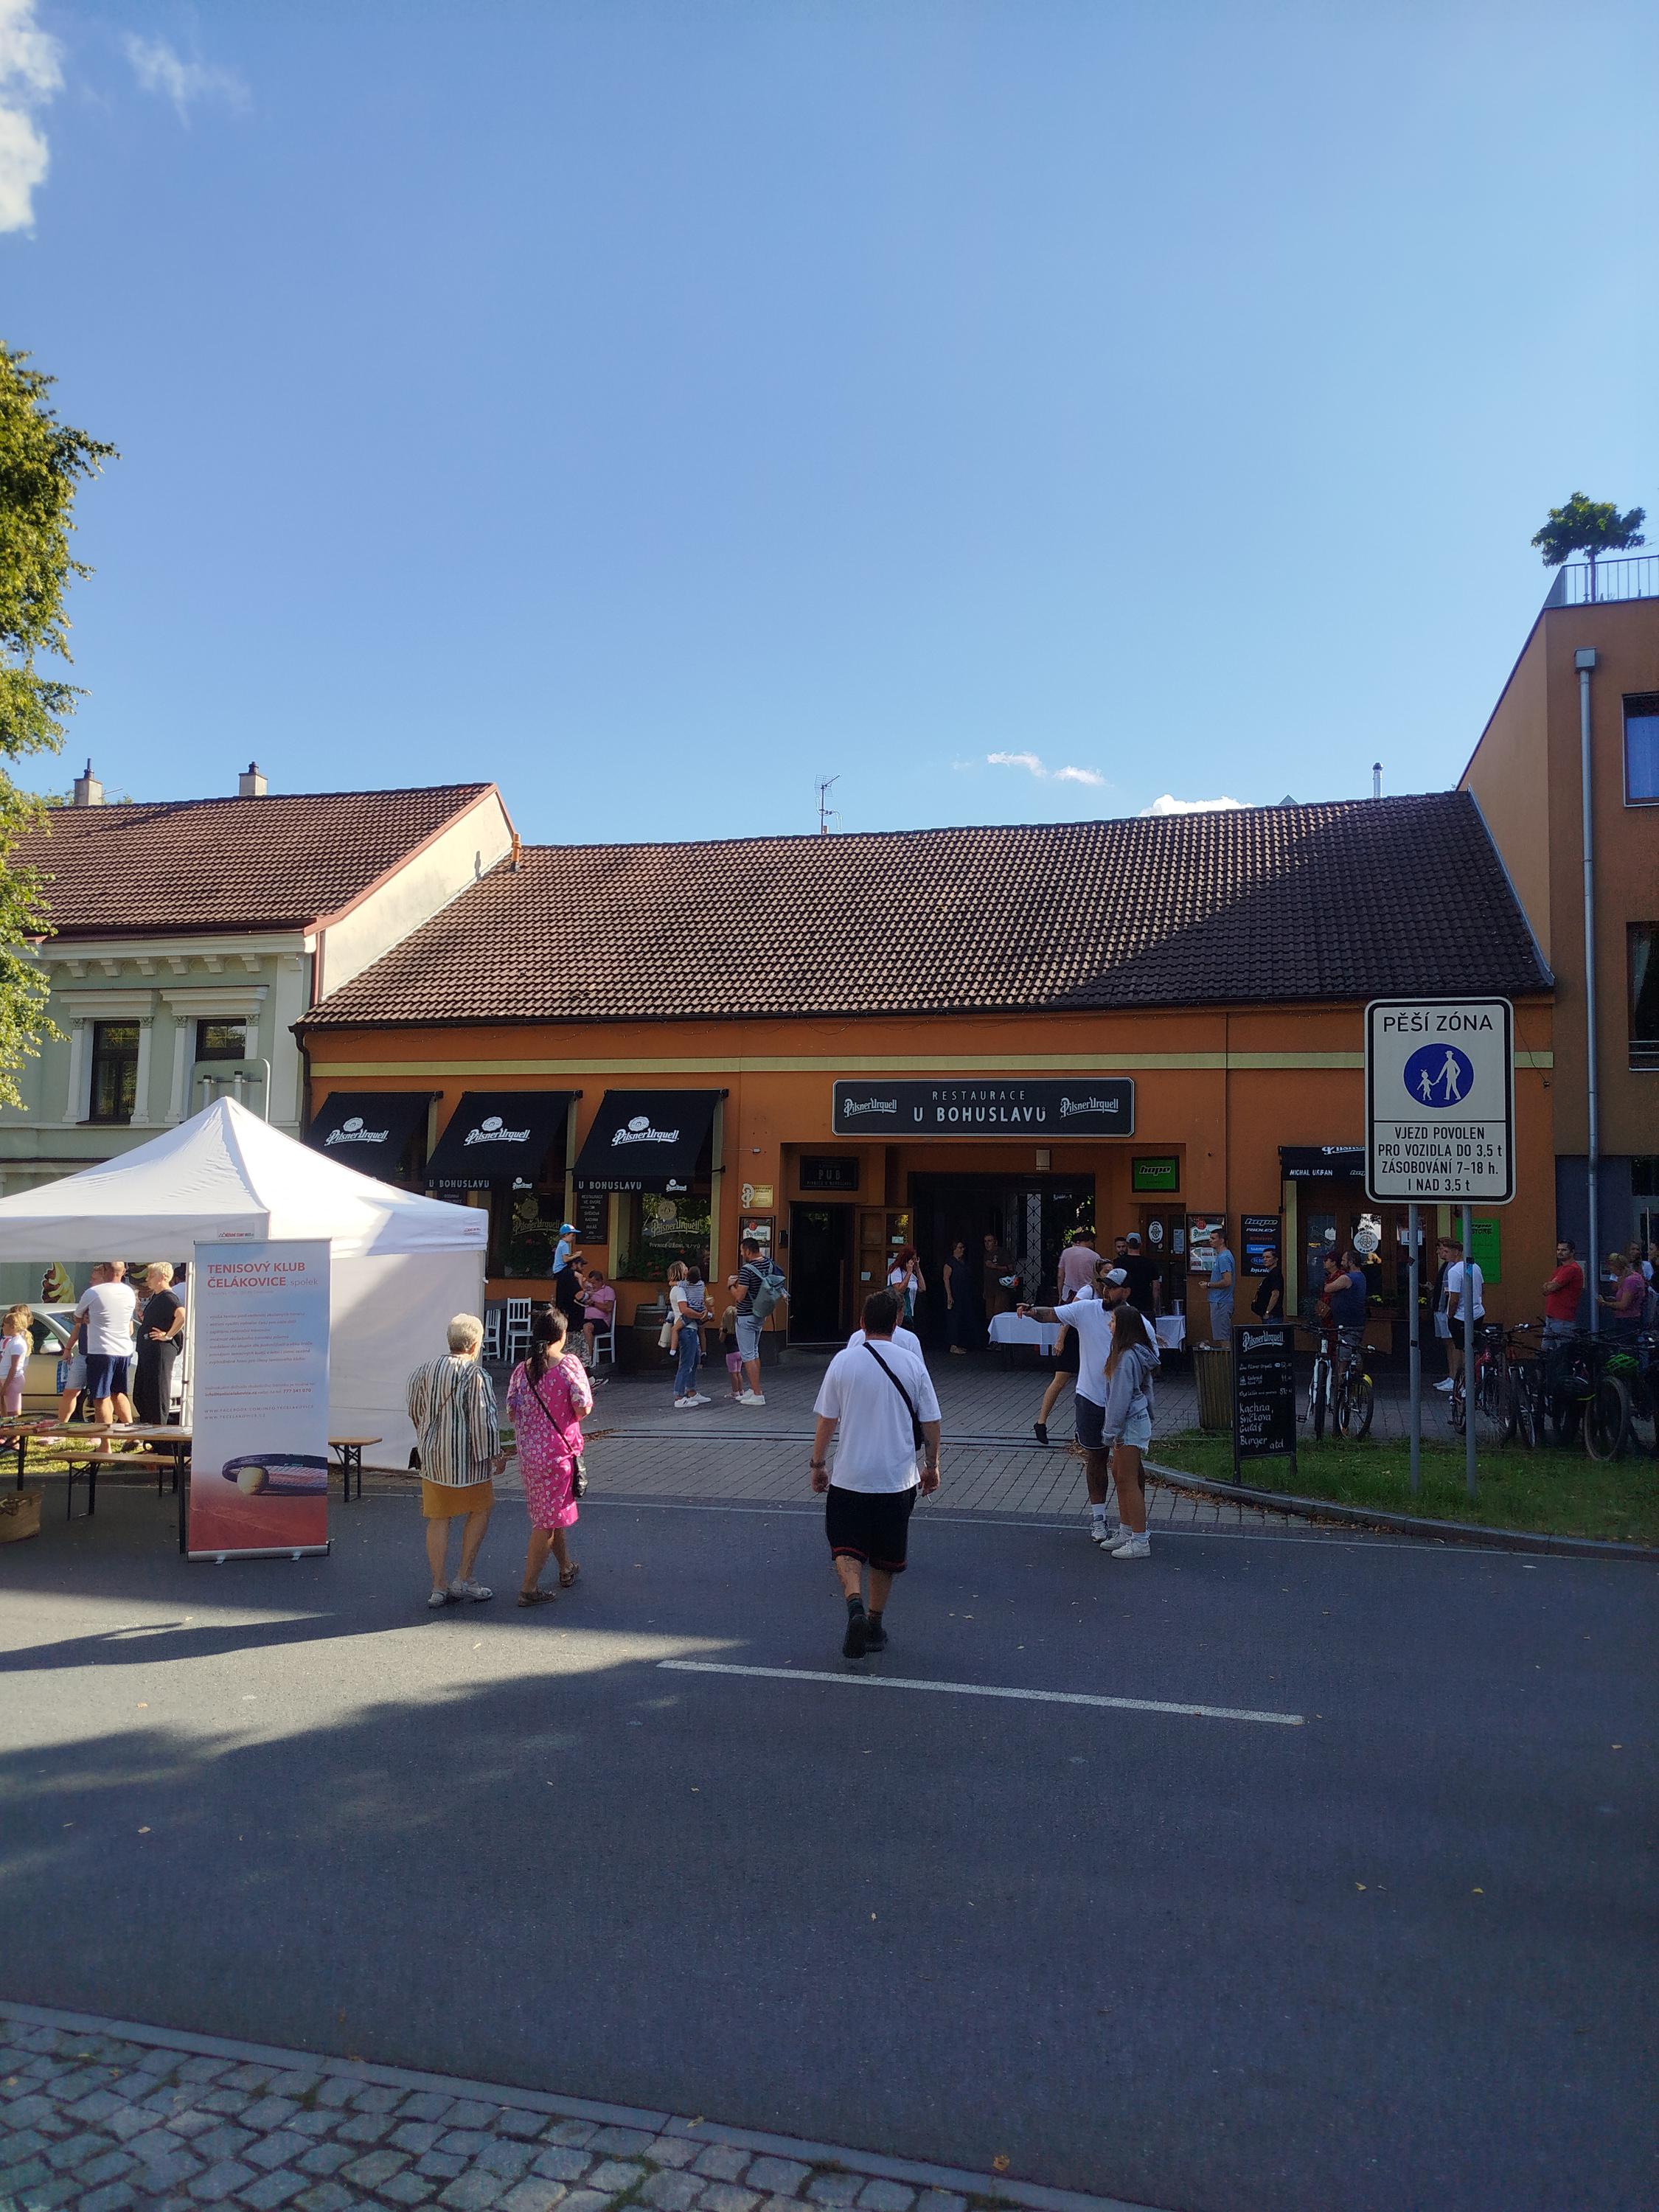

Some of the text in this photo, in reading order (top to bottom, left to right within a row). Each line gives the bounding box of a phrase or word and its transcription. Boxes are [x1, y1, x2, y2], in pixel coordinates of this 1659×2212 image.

[1383, 1011, 1493, 1032] PĚŠÍ ZÓNA
[931, 1091, 1026, 1101] RESTAURACE
[844, 1097, 897, 1117] Pilsner Urquell
[914, 1106, 1047, 1122] U BOHUSLAVŮ
[1059, 1096, 1119, 1120] Pilsner Urquell
[324, 1128, 390, 1147] Pilsner Urquell
[463, 1128, 532, 1147] Pilsner Urquell
[611, 1128, 680, 1147] Pilsner Urquell
[1395, 1127, 1484, 1139] VJEZD POVOLEN
[1378, 1144, 1502, 1158] PRO VOZIDLA DO 3,5 t
[1382, 1158, 1452, 1174] ZÁSOBOVÁNÍ
[1488, 1161, 1499, 1175] h.
[818, 1169, 841, 1180] PUB
[429, 1180, 434, 1188] U
[578, 1181, 585, 1189] U
[1408, 1178, 1470, 1192] I NAD 3,5 t
[207, 1262, 306, 1274] TENISOVÝ KLUB
[207, 1276, 319, 1289] ČELÁKOVICE spolek
[1242, 1330, 1284, 1353] Pilsner Urquell
[1239, 1436, 1268, 1449] Burger
[1269, 1440, 1284, 1450] atd
